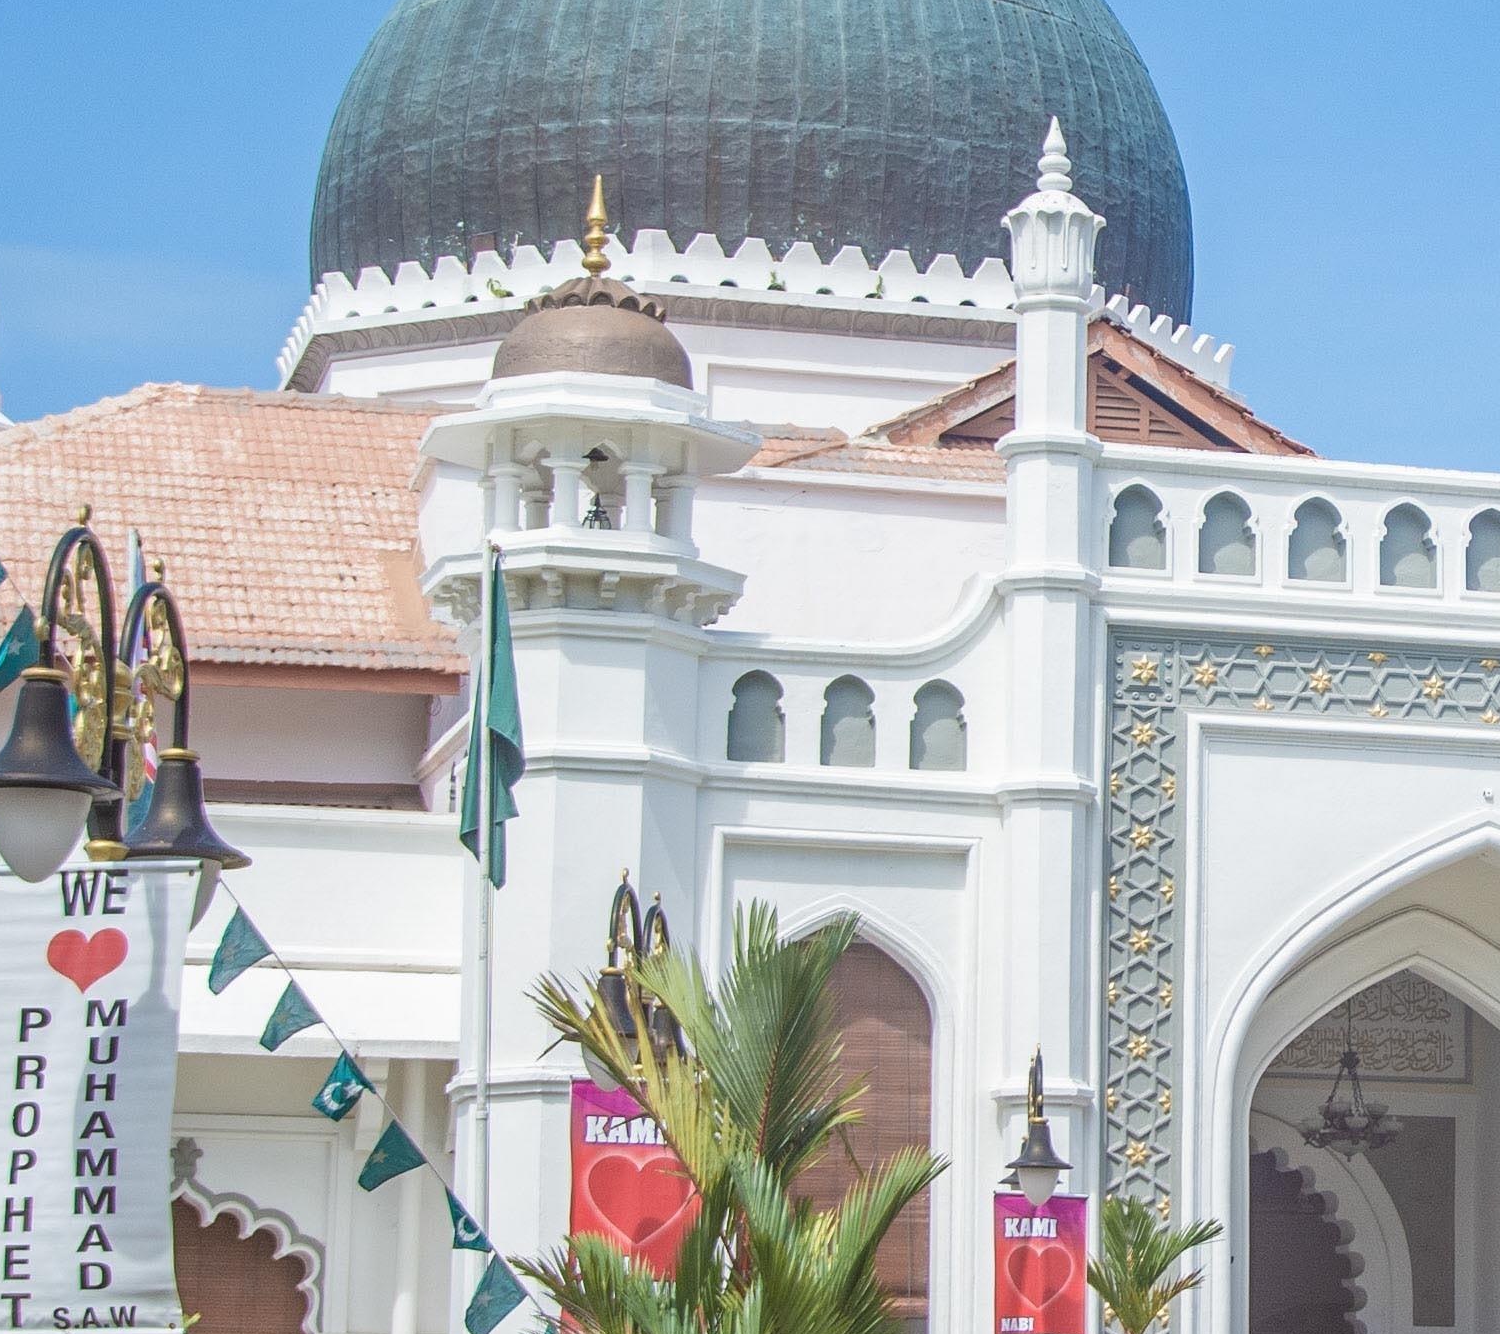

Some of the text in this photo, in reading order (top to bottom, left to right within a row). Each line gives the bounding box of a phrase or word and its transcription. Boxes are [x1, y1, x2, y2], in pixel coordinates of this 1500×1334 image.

[61, 869, 130, 917] WE
[72, 998, 129, 1291] MUHAMMAD
[1, 1007, 52, 1329] PROPHET
[1004, 1217, 1057, 1238] KAMI
[52, 1305, 137, 1330] S.A.W
[1001, 1317, 1034, 1332] NABI
